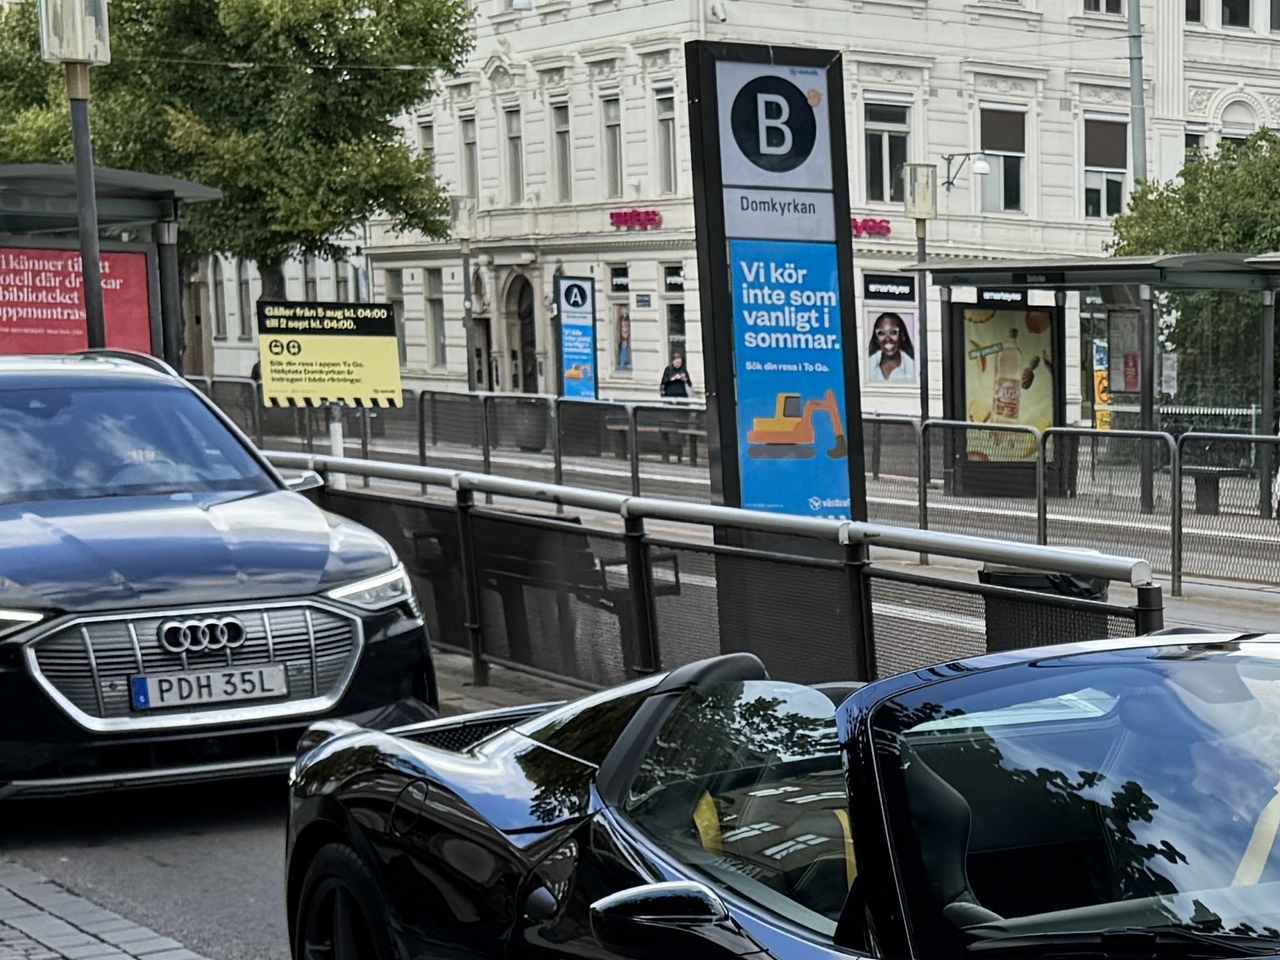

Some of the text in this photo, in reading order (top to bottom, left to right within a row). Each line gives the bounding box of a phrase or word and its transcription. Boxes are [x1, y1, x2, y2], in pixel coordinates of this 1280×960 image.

[757, 93, 793, 155] B
[740, 196, 816, 217] Domkyrkan
[9, 254, 64, 271] känner
[67, 256, 83, 273] til
[99, 261, 112, 274] tt
[740, 261, 808, 284] Vi kör
[0, 271, 33, 286] otell
[36, 273, 62, 288] där
[570, 287, 583, 305] A
[742, 283, 837, 306] inte som
[265, 306, 294, 316] Gäller
[296, 307, 316, 317] från
[326, 309, 343, 319] aug
[357, 308, 388, 319] 04:00
[743, 306, 830, 332] vanligt i
[266, 318, 279, 328] till
[280, 318, 287, 328] 2
[288, 319, 309, 330] sept
[744, 331, 841, 349] sommar.
[745, 361, 763, 370] Sök
[764, 362, 777, 371] din
[778, 363, 798, 371] resa
[803, 363, 814, 372] To
[158, 670, 275, 702] PDH 35L
